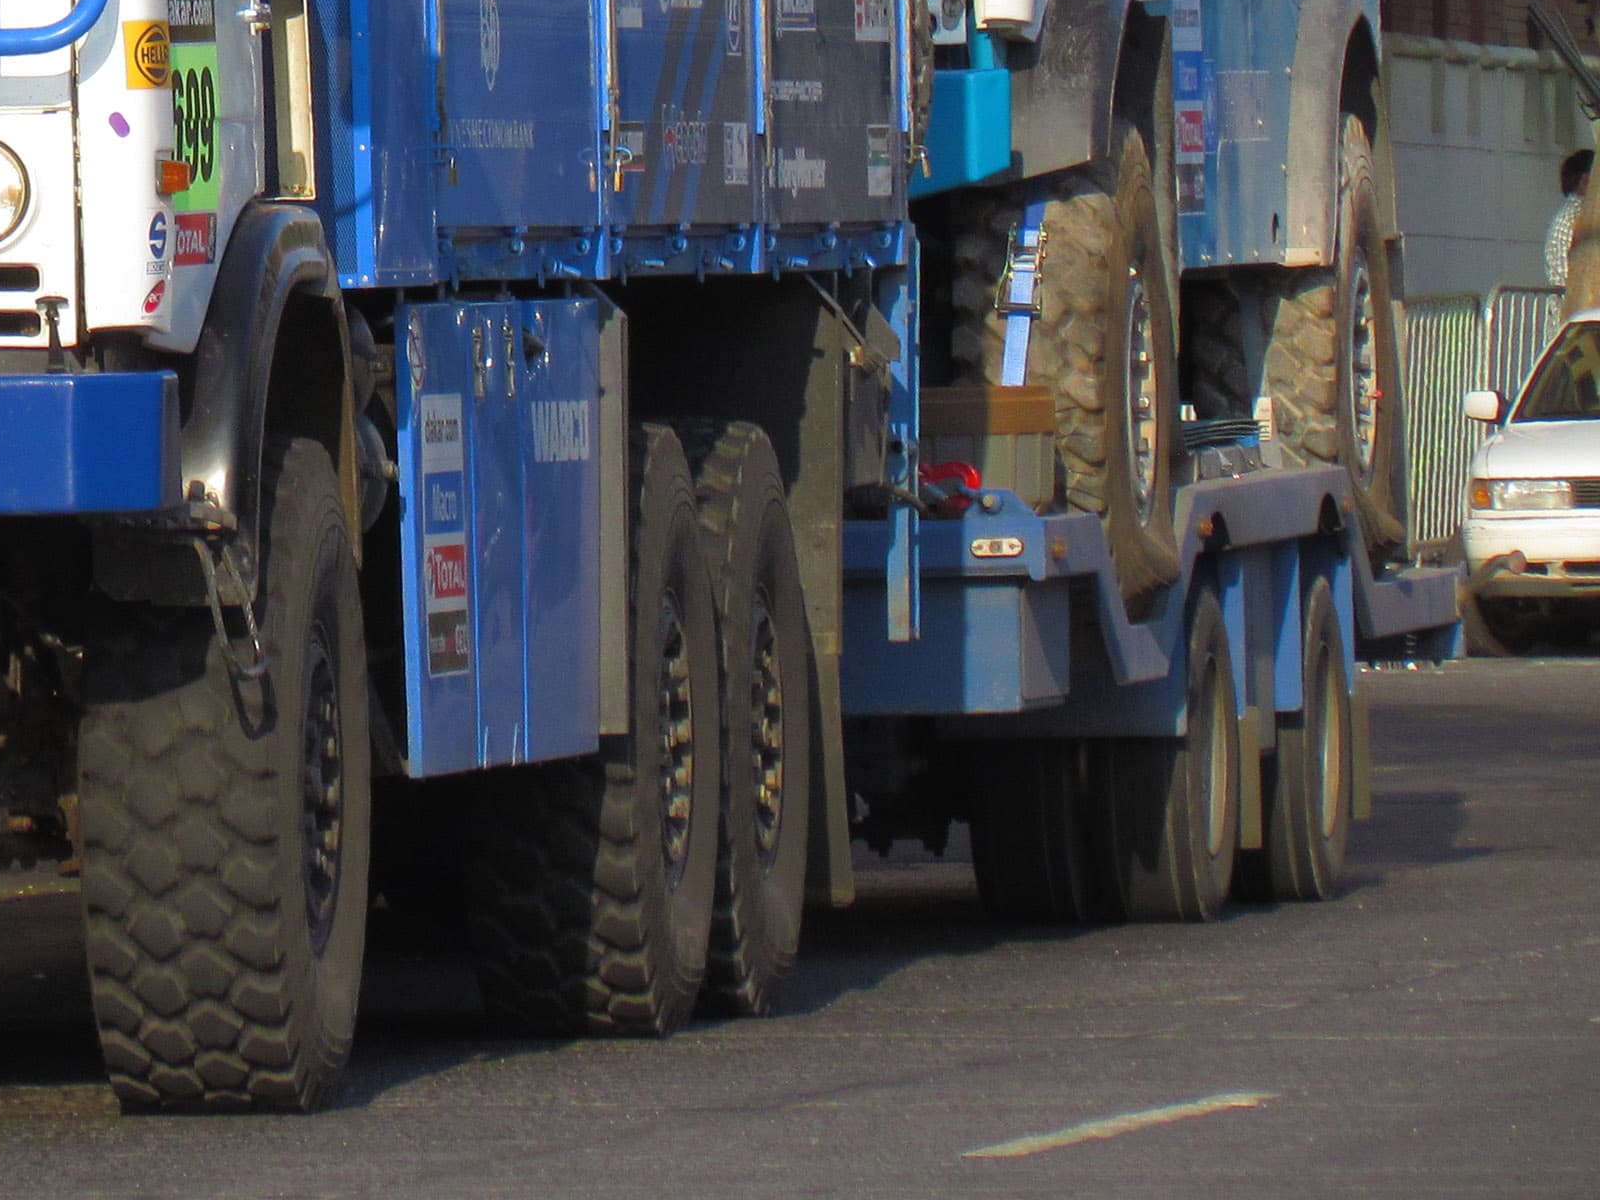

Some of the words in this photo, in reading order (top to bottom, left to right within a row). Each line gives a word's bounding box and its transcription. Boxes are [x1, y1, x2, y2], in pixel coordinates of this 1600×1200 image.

[170, 66, 216, 184] 699
[531, 400, 590, 462] WABCO
[431, 483, 459, 522] Macro
[436, 553, 466, 590] TOTAL
